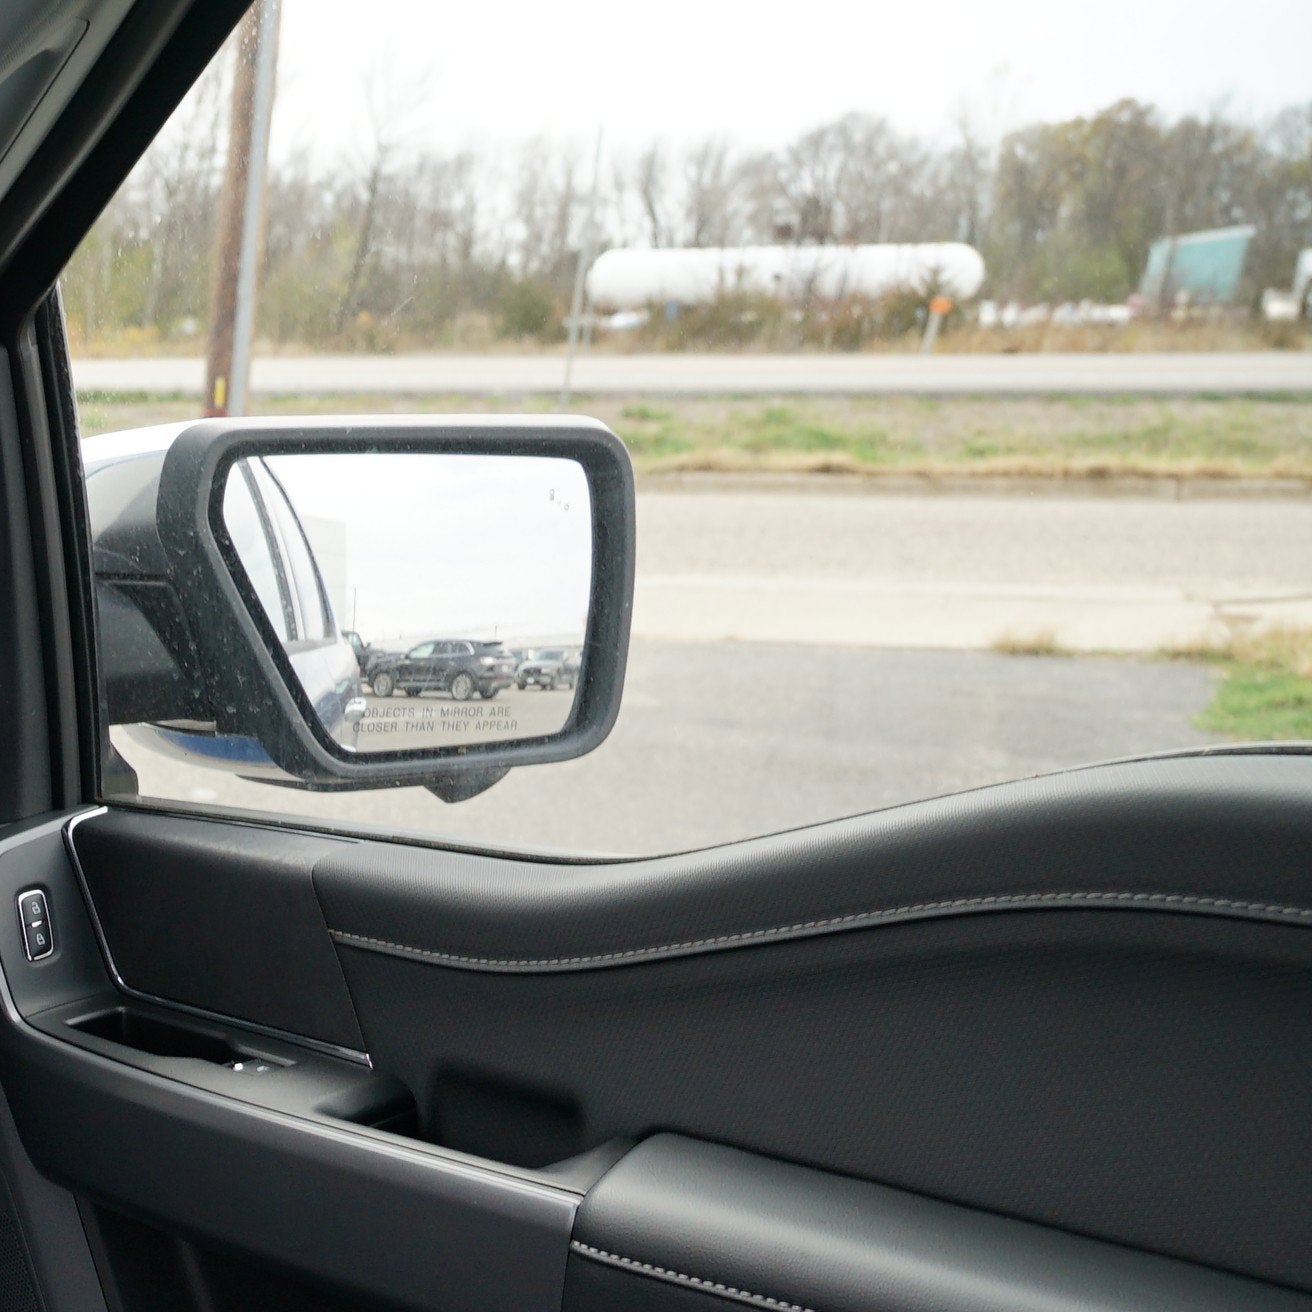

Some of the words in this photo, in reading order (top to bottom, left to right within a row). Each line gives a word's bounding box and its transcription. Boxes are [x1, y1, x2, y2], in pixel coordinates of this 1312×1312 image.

[363, 707, 415, 718] OBJECTS
[422, 706, 433, 718] IN
[440, 706, 484, 718] MIRROR
[489, 706, 511, 717] ARE
[405, 721, 434, 732] THAN
[442, 720, 469, 732] THEY
[475, 719, 518, 731] APPEAR
